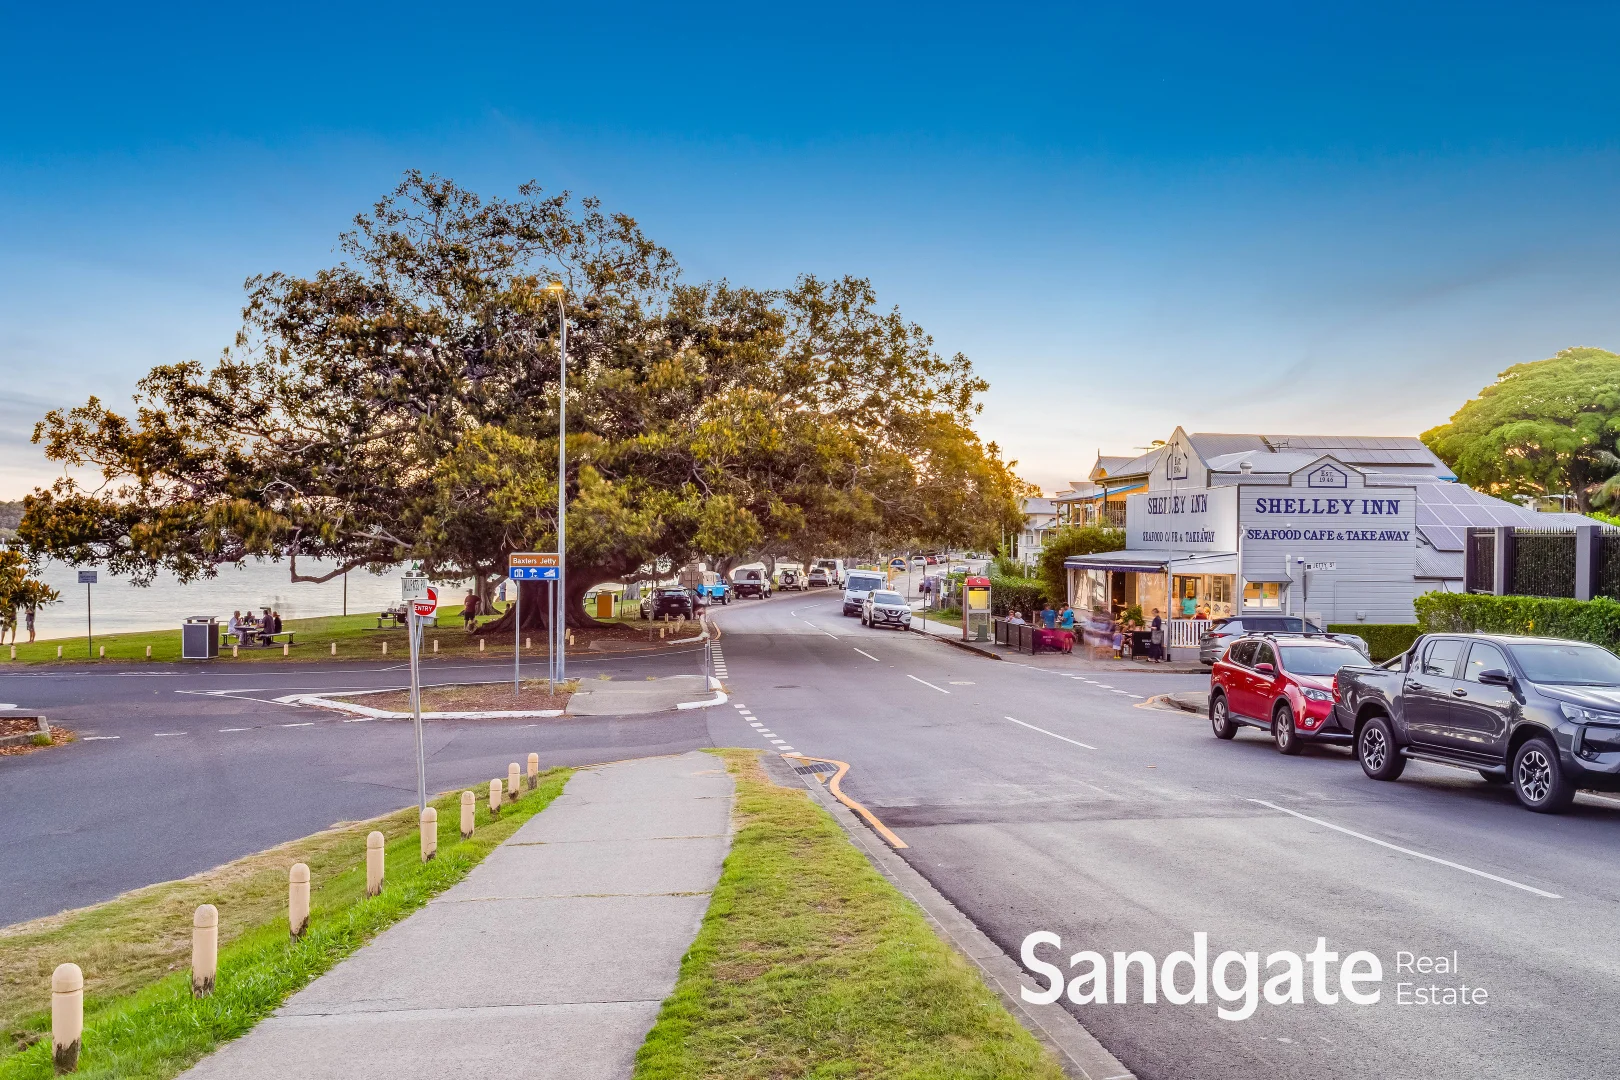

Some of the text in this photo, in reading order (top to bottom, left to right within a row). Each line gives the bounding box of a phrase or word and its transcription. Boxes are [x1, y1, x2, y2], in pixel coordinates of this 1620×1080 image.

[1190, 494, 1208, 513] INN
[1255, 497, 1401, 515] SHELLEY INN
[1142, 531, 1163, 542] SEAFOOD
[1184, 531, 1215, 543] TAKEAWAY
[1247, 529, 1411, 541] SEAFOOD CAFE & TAKEAWAY
[540, 557, 557, 566] Jetty
